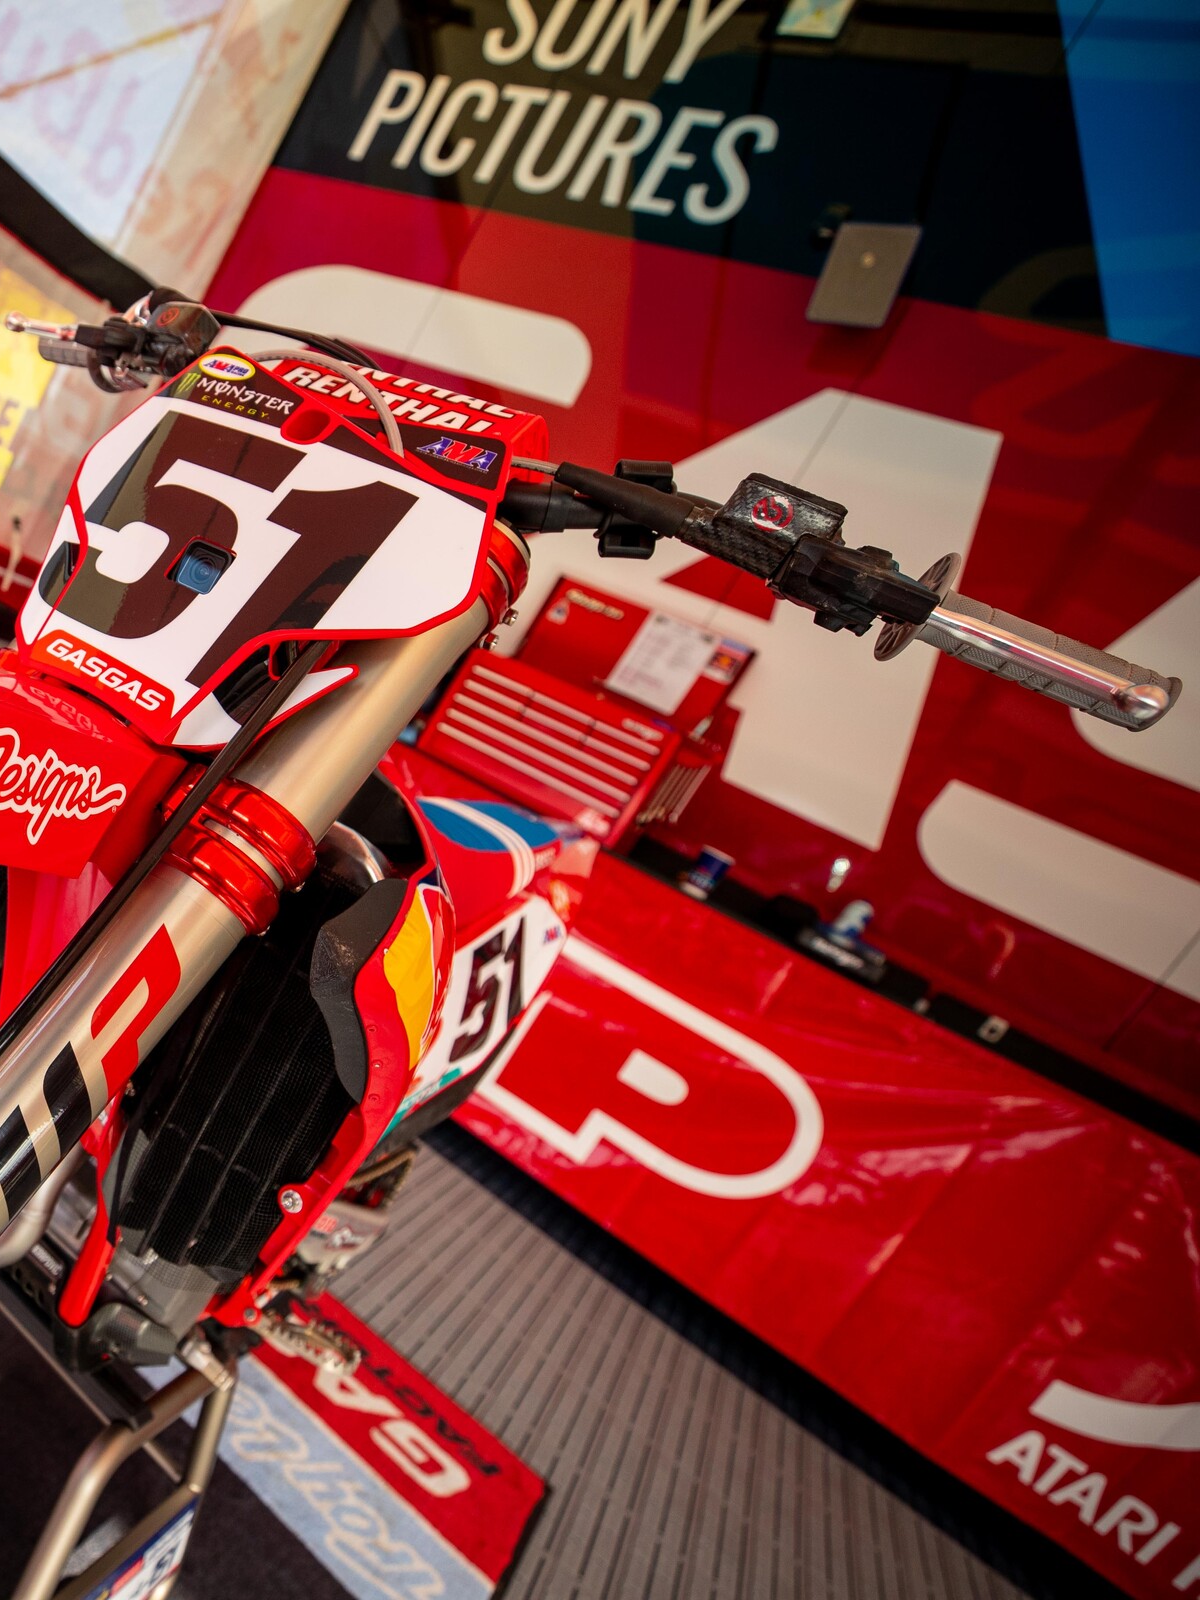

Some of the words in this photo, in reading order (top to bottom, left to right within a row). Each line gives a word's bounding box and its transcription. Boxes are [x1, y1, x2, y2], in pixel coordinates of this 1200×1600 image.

[347, 68, 780, 226] PICTURES
[201, 395, 270, 419] ENERGY
[416, 436, 498, 472] AMA
[38, 410, 420, 726] 51
[46, 638, 166, 712] GASGAS
[449, 915, 528, 1063] 51
[985, 1429, 1182, 1567] ATARI
